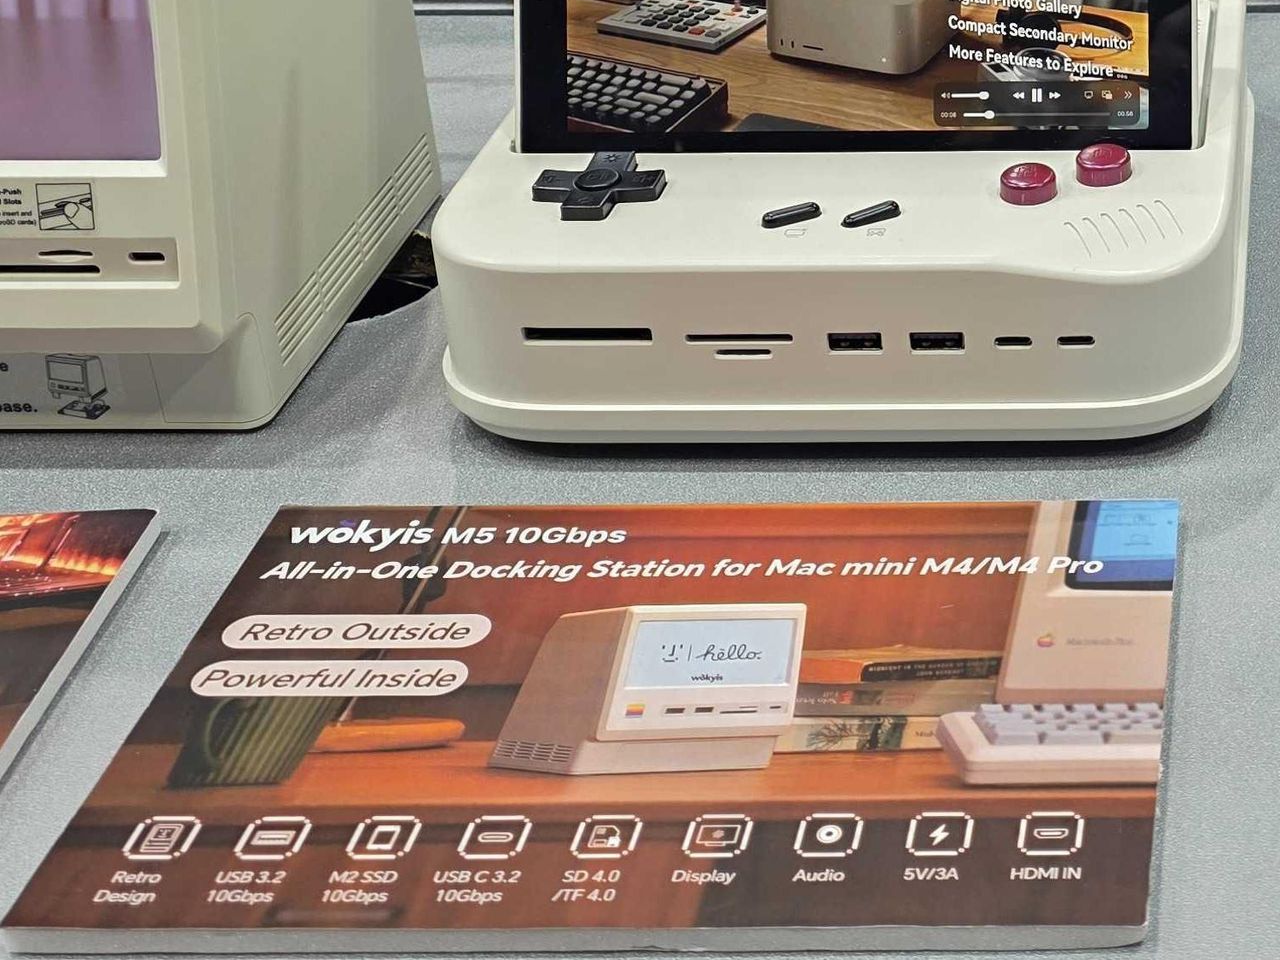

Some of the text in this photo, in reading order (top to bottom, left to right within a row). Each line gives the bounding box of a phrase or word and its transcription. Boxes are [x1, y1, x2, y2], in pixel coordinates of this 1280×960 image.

[948, 16, 1134, 51] Compact Secondary Monitor
[950, 44, 982, 61] More
[986, 48, 1043, 68] Features
[1046, 56, 1060, 70] to
[1064, 58, 1114, 77] Explore
[440, 527, 497, 544] M5
[505, 526, 628, 548] 10Gbps
[259, 556, 1105, 583] All-in-One Docking Station for Mac mini M4/M4 Pro
[239, 622, 472, 641] Retro Outside
[197, 668, 458, 688] Powerful Inside
[110, 870, 162, 884] Retro
[214, 870, 287, 884] USB 3.2
[328, 870, 398, 884] M2 SSD
[433, 870, 522, 884] USB C 3.2
[562, 870, 621, 883] SD 4.0
[671, 869, 736, 885] Display
[792, 868, 846, 883] Audio
[903, 867, 960, 882] 5V/3A
[1010, 867, 1082, 880] HDMI IN
[92, 890, 156, 906] Design
[206, 889, 274, 906] 10Gbps
[322, 889, 388, 905] 10Gbps
[436, 889, 503, 905] 10Gbps
[551, 888, 616, 902] /TF 4.0
